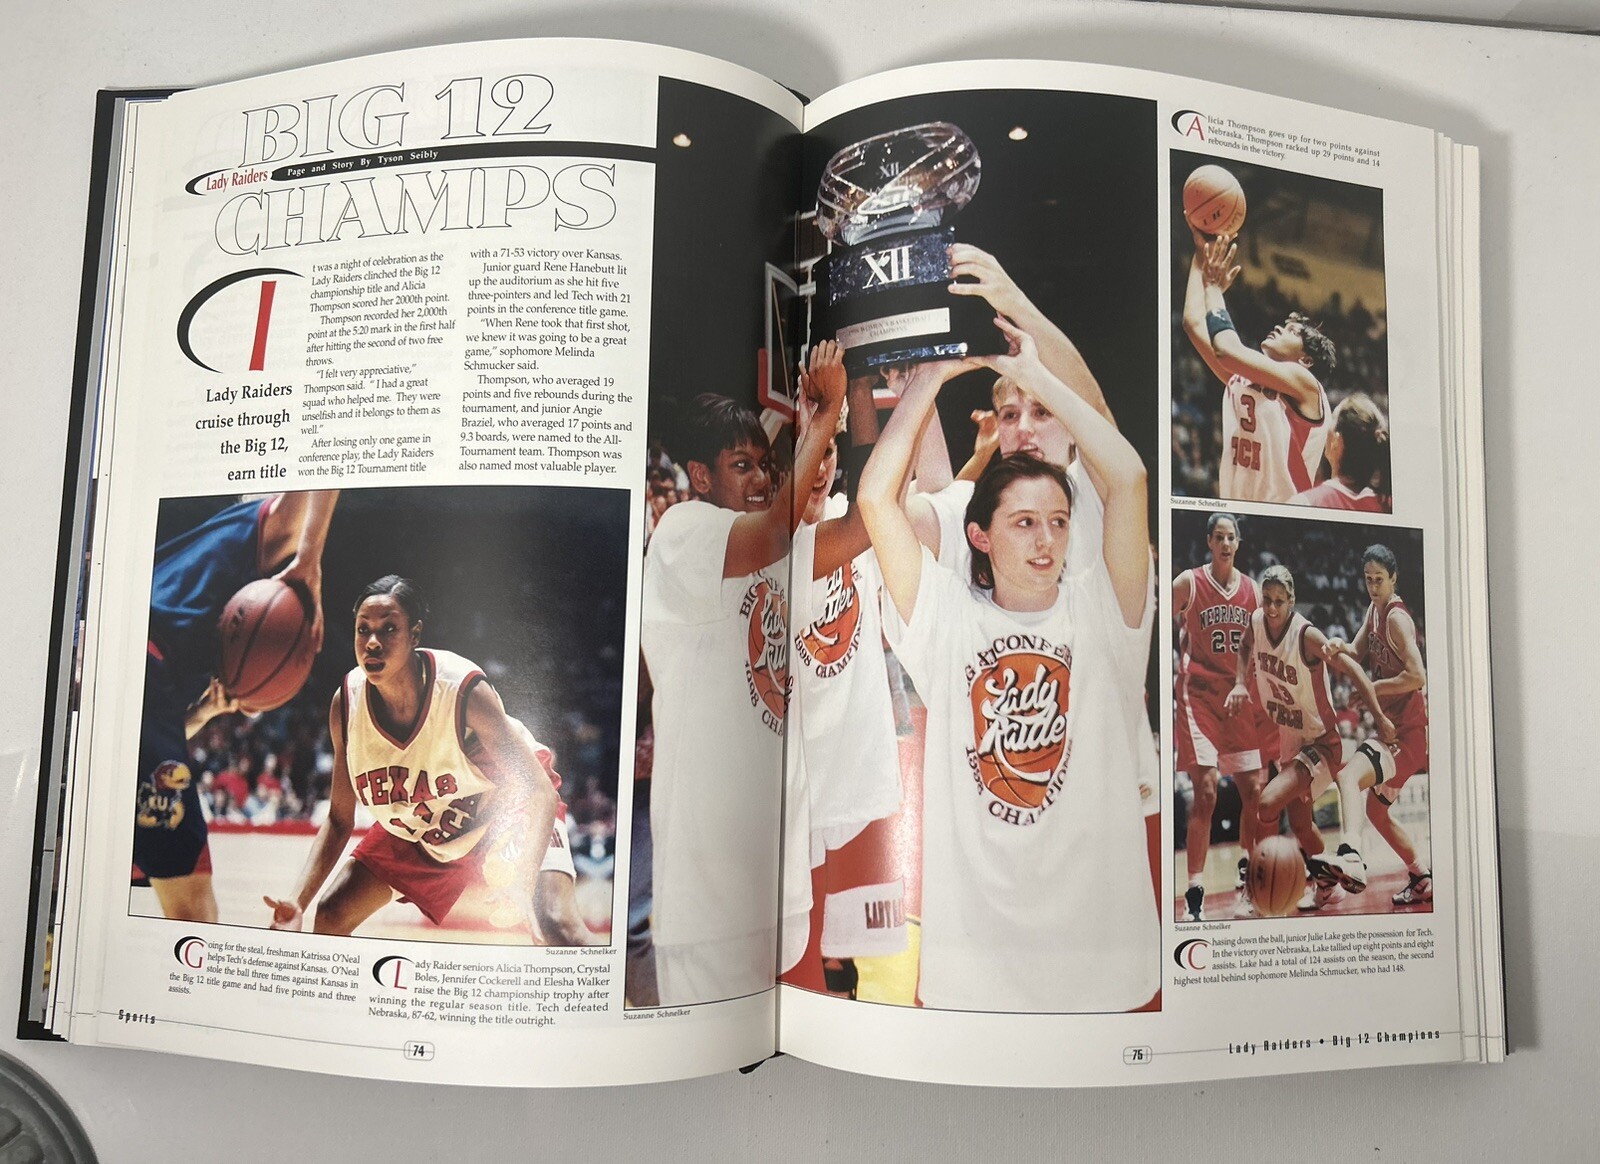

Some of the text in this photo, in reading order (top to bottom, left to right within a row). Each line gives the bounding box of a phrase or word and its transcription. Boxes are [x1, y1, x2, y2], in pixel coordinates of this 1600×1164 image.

[239, 74, 554, 168] BIG 12
[1207, 125, 1380, 167] Nebraska. Thompson racked up 29 points and 14
[1207, 137, 1241, 149] rebounds
[1249, 144, 1261, 154] the
[1261, 148, 1285, 161] victory.
[287, 149, 438, 177] Page and Story By Tyson Seibly
[206, 168, 269, 193] Lady Raiders
[215, 163, 618, 256] CHAMPS
[312, 264, 316, 273] t
[317, 263, 333, 272] was
[340, 258, 361, 272] night
[362, 257, 371, 267] of
[372, 254, 417, 266] celebration
[418, 254, 428, 262] as
[430, 251, 444, 261] the
[470, 247, 622, 261] with a 71-53 victory over Kansas.
[311, 265, 441, 287] Lady Raiders clinched the Big 12
[483, 261, 627, 275] Junior guard Rene Hanebutt lit
[861, 245, 915, 289] XII
[206, 382, 292, 405] Lady Raiders
[195, 408, 290, 430] cruise through
[220, 436, 288, 456] the Big 12,
[227, 463, 287, 481] earn title
[1211, 629, 1243, 654] 25
[355, 765, 459, 807] TEXAS
[1212, 927, 1434, 948] hasing down the ball, junior Julie Lake gets the possession for Tech.
[208, 940, 360, 964] oing for the steal, freshman Katrissa O'Neal
[580, 947, 617, 955] Schnelker
[415, 959, 610, 976] ady Raider seniors Alicia Thompson, Crystal
[414, 972, 610, 986] Boles, Jennifer Cockerell and Elesha Walker
[413, 985, 610, 1001] raise the Big 12 championship trophy after
[118, 1009, 156, 1025] Sports
[623, 1008, 691, 1020] Suzanne Schnelker
[412, 1044, 425, 1058] 74
[1228, 1030, 1441, 1055] Lady Raiders Big 12 Champions
[1132, 1049, 1144, 1062] 75
